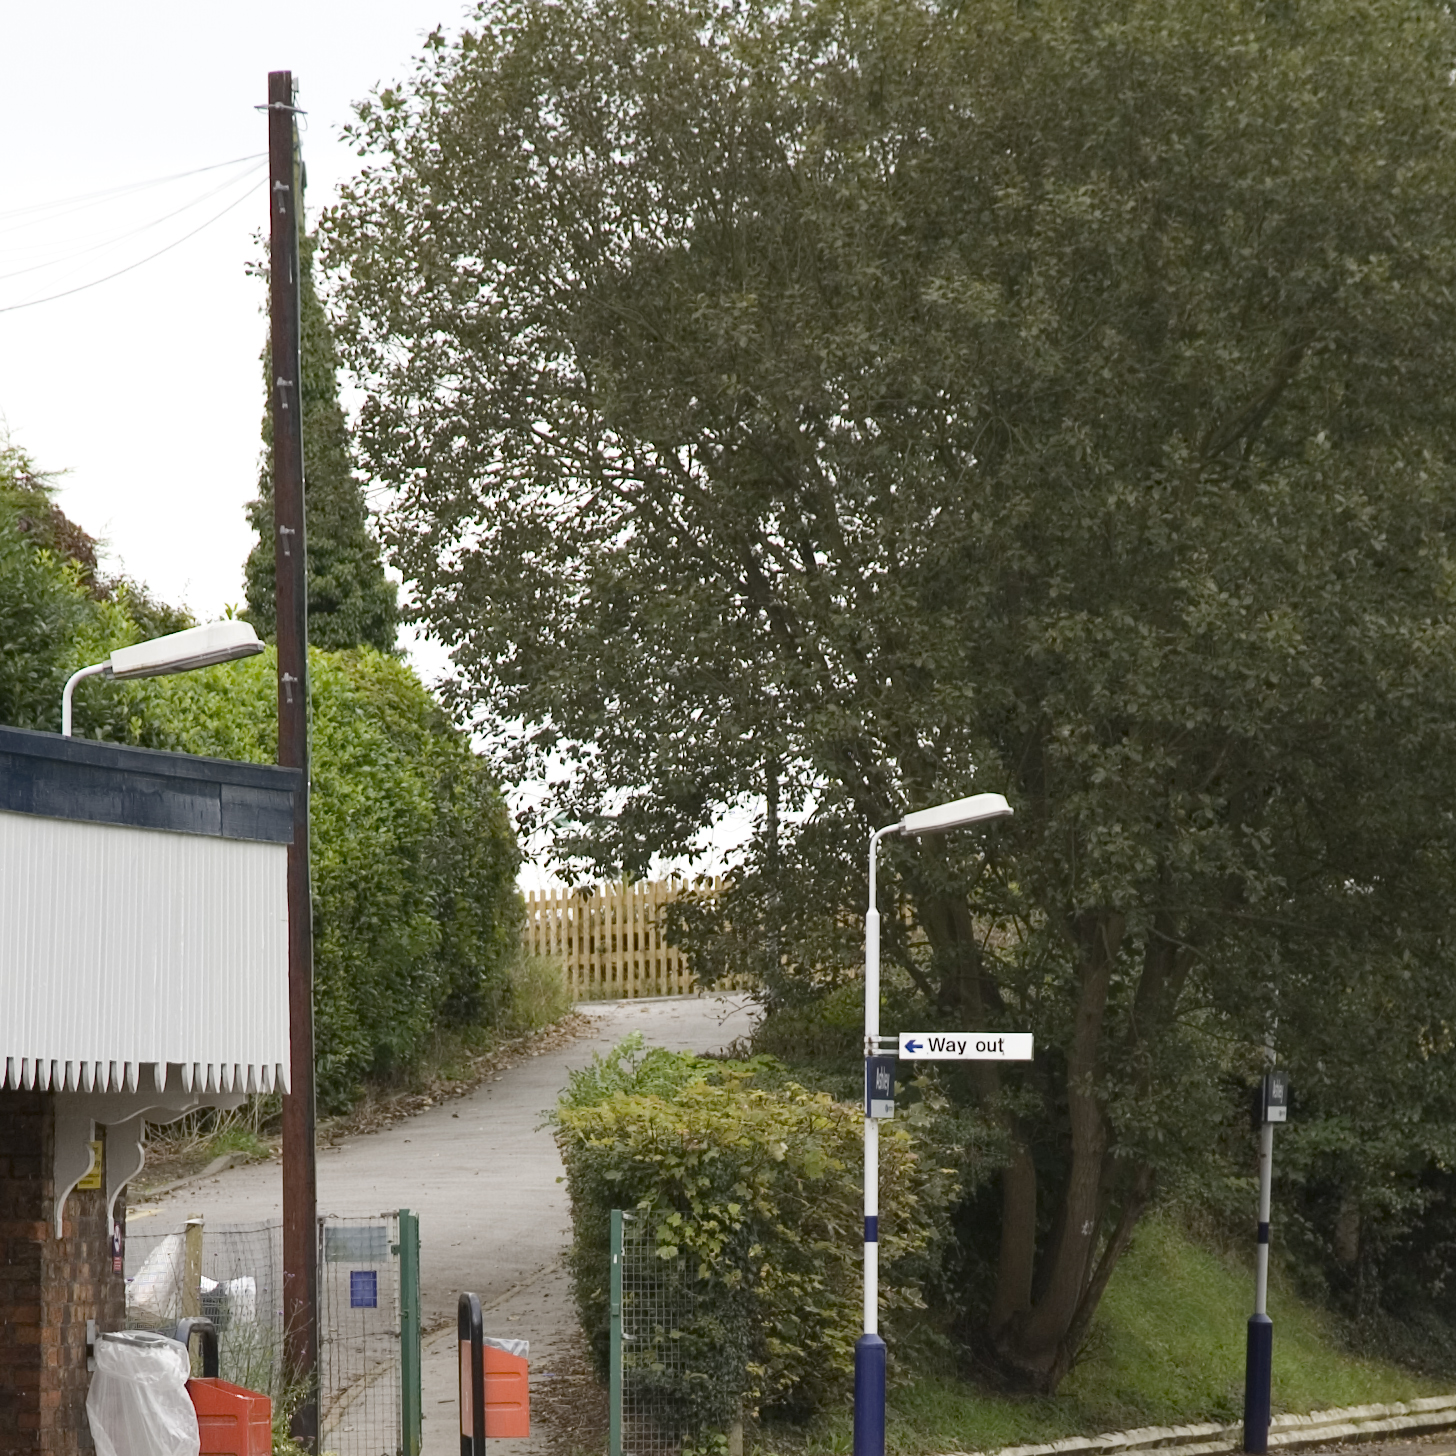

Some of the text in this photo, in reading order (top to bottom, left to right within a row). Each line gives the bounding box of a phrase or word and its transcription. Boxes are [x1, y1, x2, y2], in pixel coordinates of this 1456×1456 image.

[927, 1037, 1005, 1055] Way out
[876, 1065, 890, 1097] Ashley
